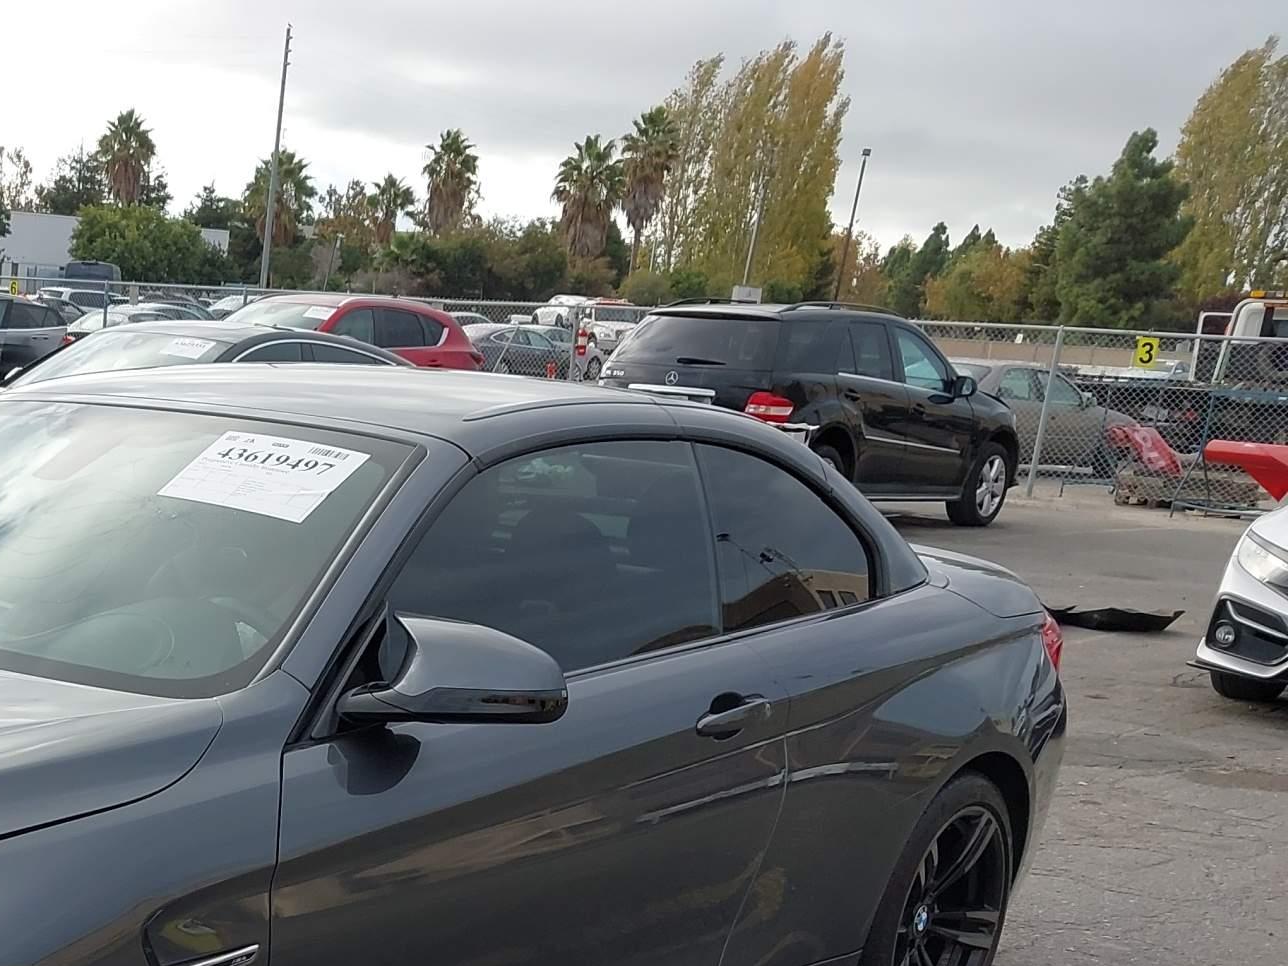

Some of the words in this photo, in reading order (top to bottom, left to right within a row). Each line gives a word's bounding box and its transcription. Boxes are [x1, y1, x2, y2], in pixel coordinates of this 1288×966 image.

[11, 281, 17, 295] 6
[1139, 342, 1154, 364] 3
[217, 447, 336, 475] 43619497
